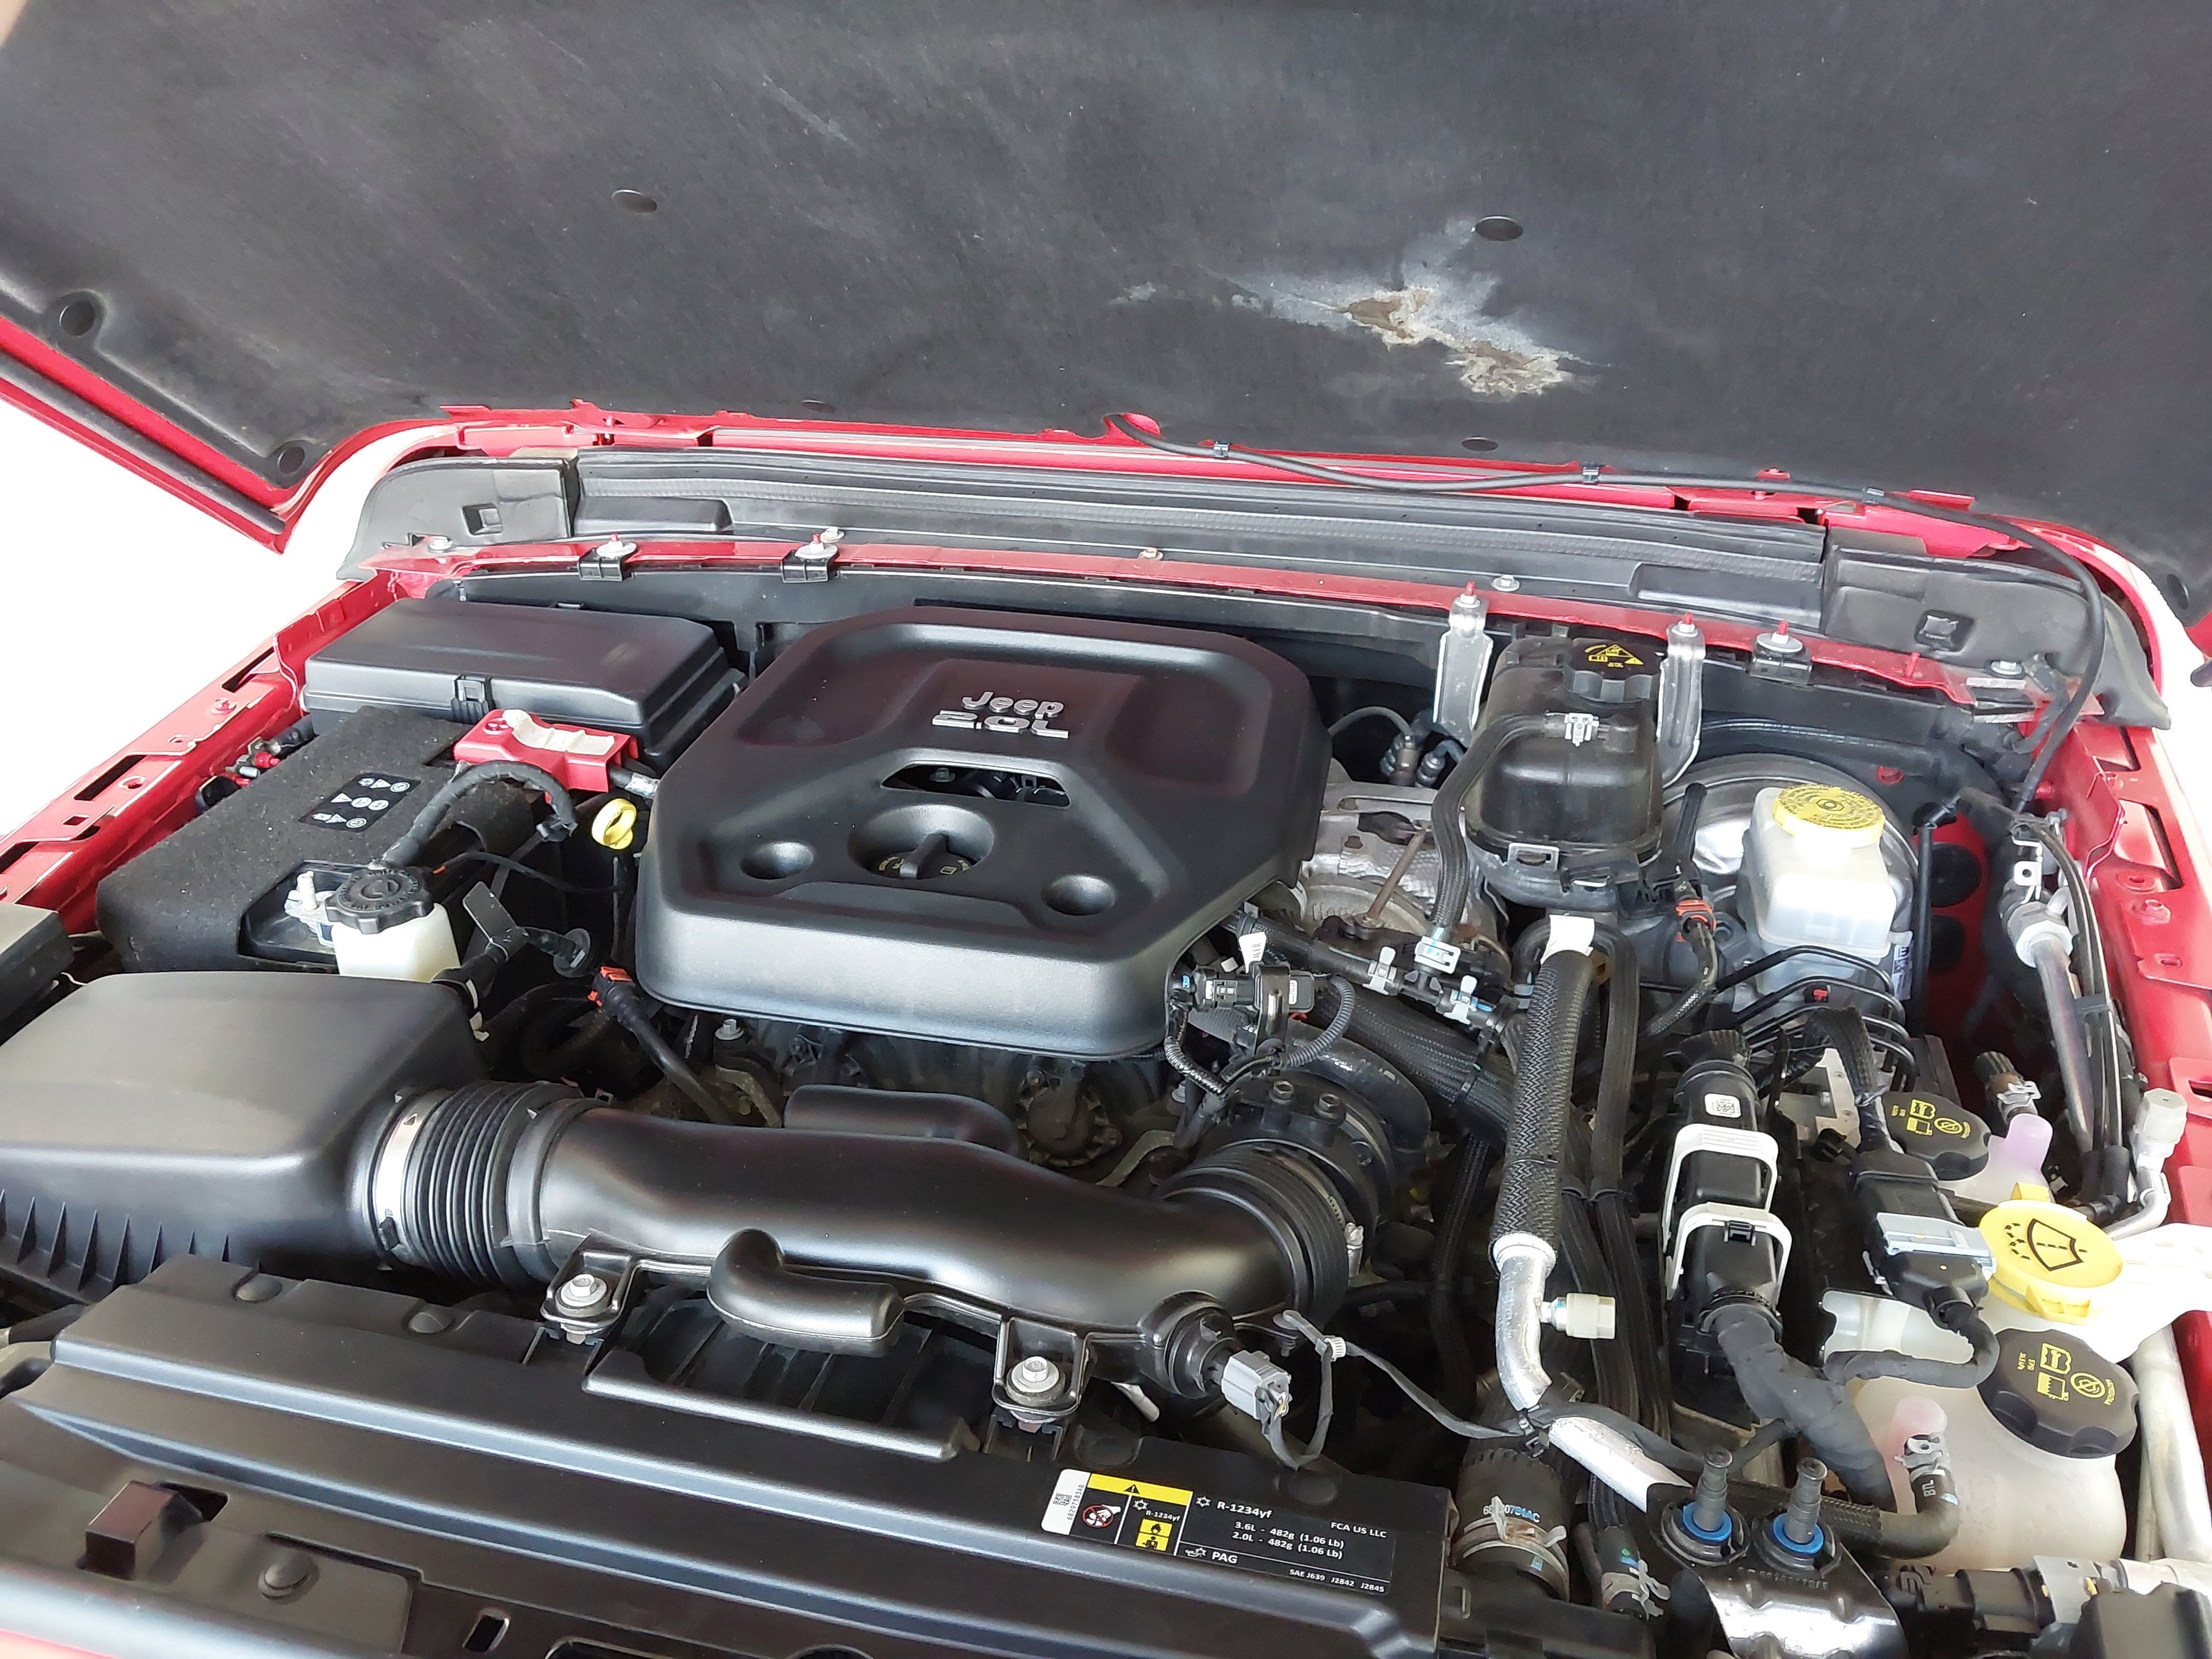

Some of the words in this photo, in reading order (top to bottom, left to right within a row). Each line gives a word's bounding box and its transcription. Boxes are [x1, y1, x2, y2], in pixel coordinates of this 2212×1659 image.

[962, 691, 1064, 719] Jeep
[931, 710, 1070, 739] 2.0L
[1145, 1510, 1181, 1522] R-1234yf
[1217, 1501, 1273, 1519] R-1234yf
[1234, 1521, 1256, 1532] 3.6L
[1269, 1528, 1295, 1540] 482g
[1300, 1533, 1326, 1545] (1.06
[1328, 1539, 1344, 1549] Lb)
[1330, 1522, 1351, 1532] FCA
[1353, 1526, 1367, 1535] US
[1369, 1529, 1387, 1538] LLC
[1212, 1551, 1238, 1564] PAG
[1232, 1532, 1254, 1542] 2.0L
[1268, 1538, 1294, 1551] 482g
[1298, 1543, 1324, 1555] (1.06
[1326, 1549, 1342, 1560] Lb)
[1289, 1568, 1306, 1577] SAE
[1306, 1572, 1326, 1581] J639
[1330, 1577, 1355, 1587] J2842
[1360, 1582, 1385, 1592] J2845
